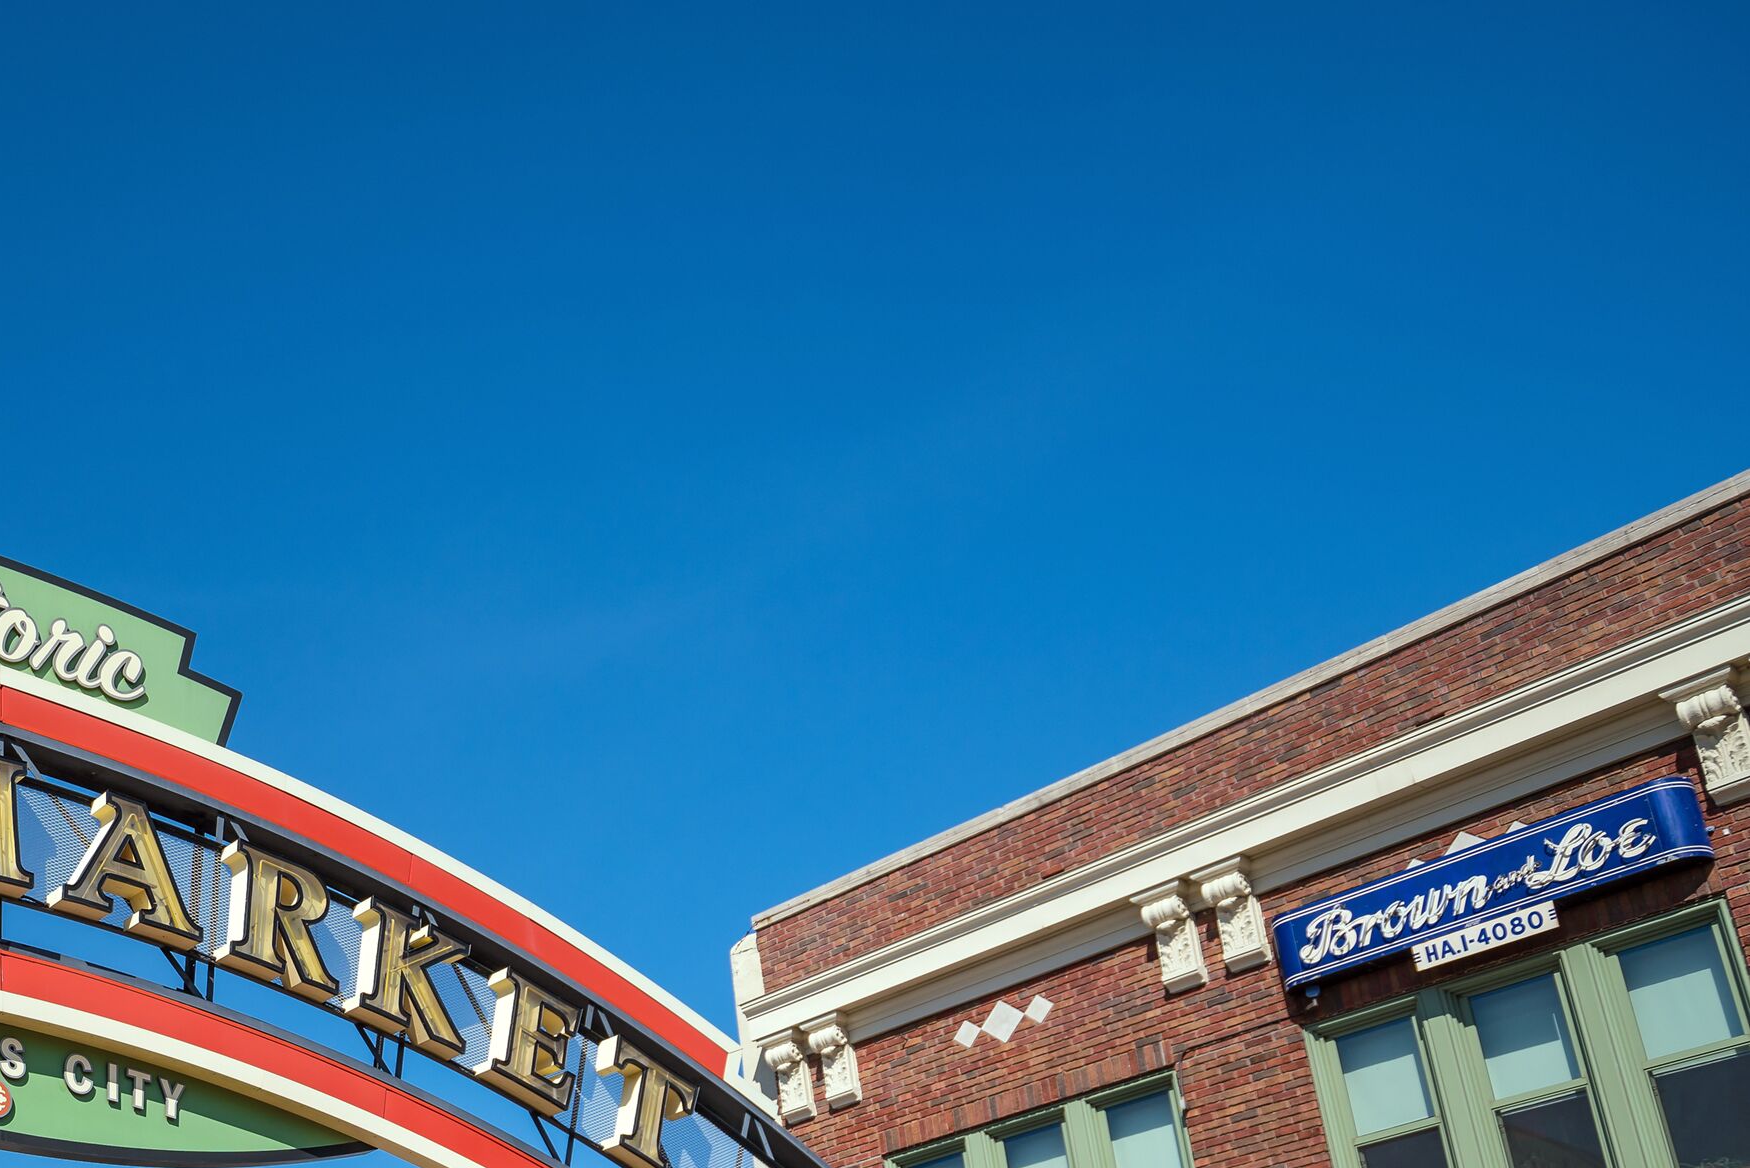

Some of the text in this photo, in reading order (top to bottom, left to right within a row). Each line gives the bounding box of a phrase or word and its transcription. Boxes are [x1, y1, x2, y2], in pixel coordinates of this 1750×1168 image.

[1299, 817, 1657, 965] Brown and Loe
[64, 1053, 186, 1119] CITY
